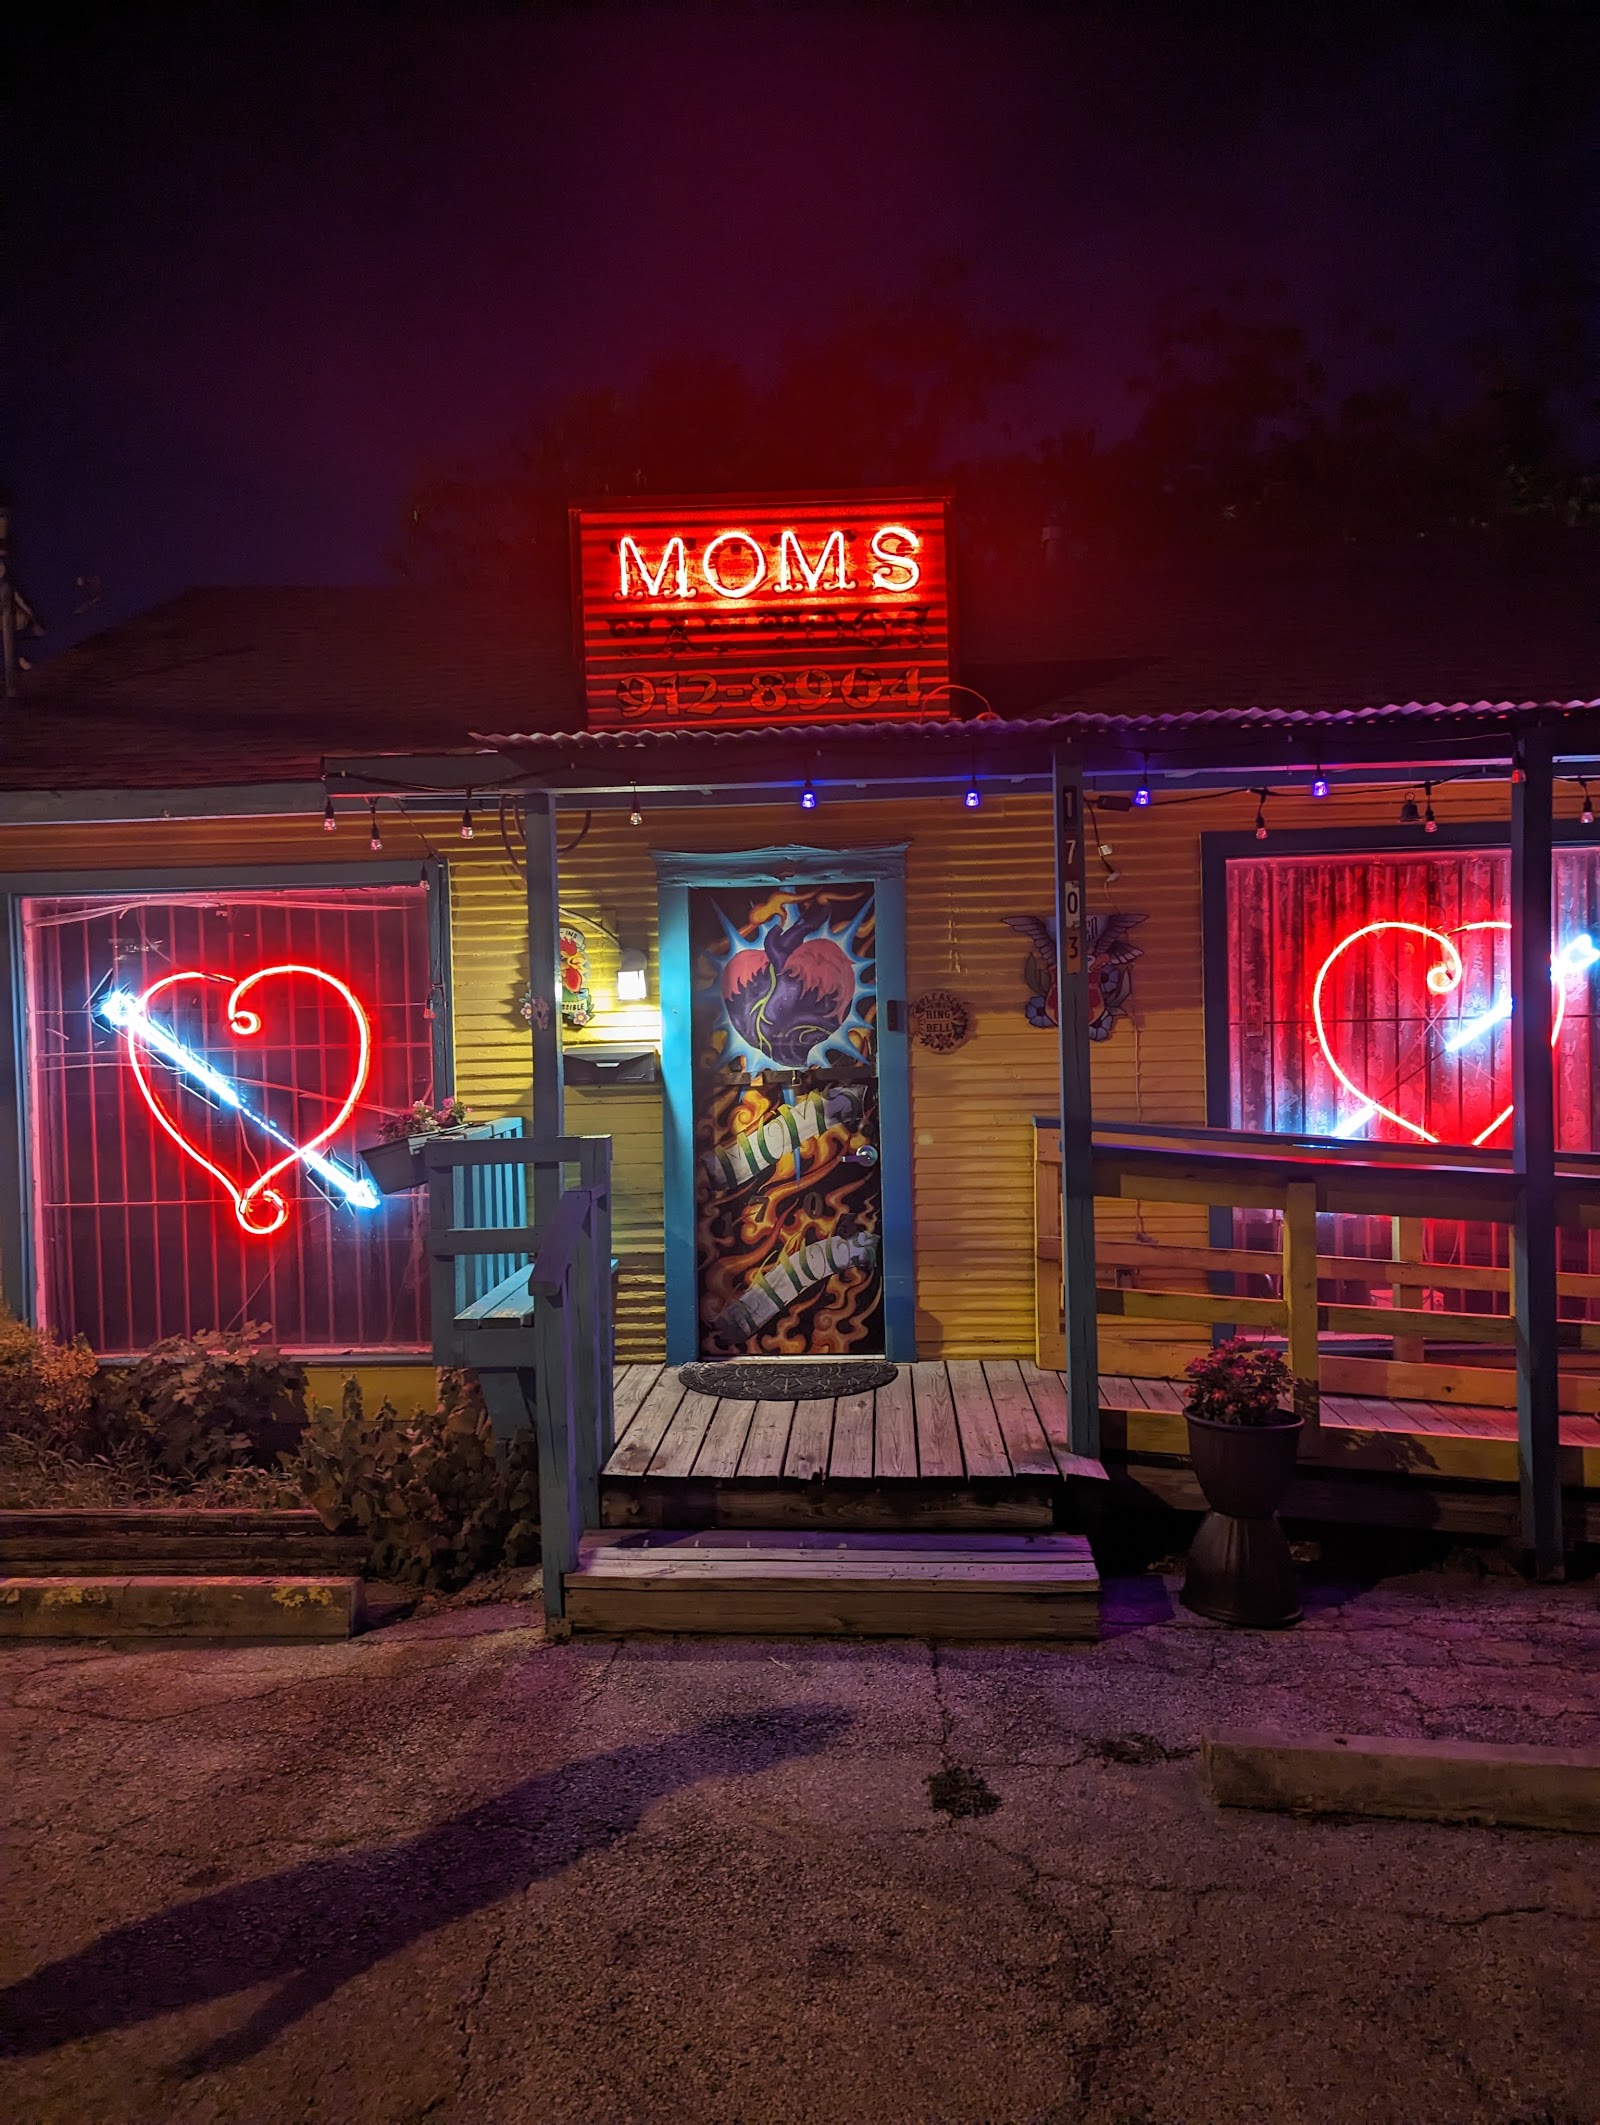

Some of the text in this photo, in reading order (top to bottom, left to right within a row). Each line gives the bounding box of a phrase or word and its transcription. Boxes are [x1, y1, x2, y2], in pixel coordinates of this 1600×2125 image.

[612, 526, 921, 600] MOMS
[616, 666, 922, 718] 912-8904
[920, 993, 957, 1006] PLEASE
[926, 1010, 951, 1019] RING
[926, 1023, 952, 1032] BELL
